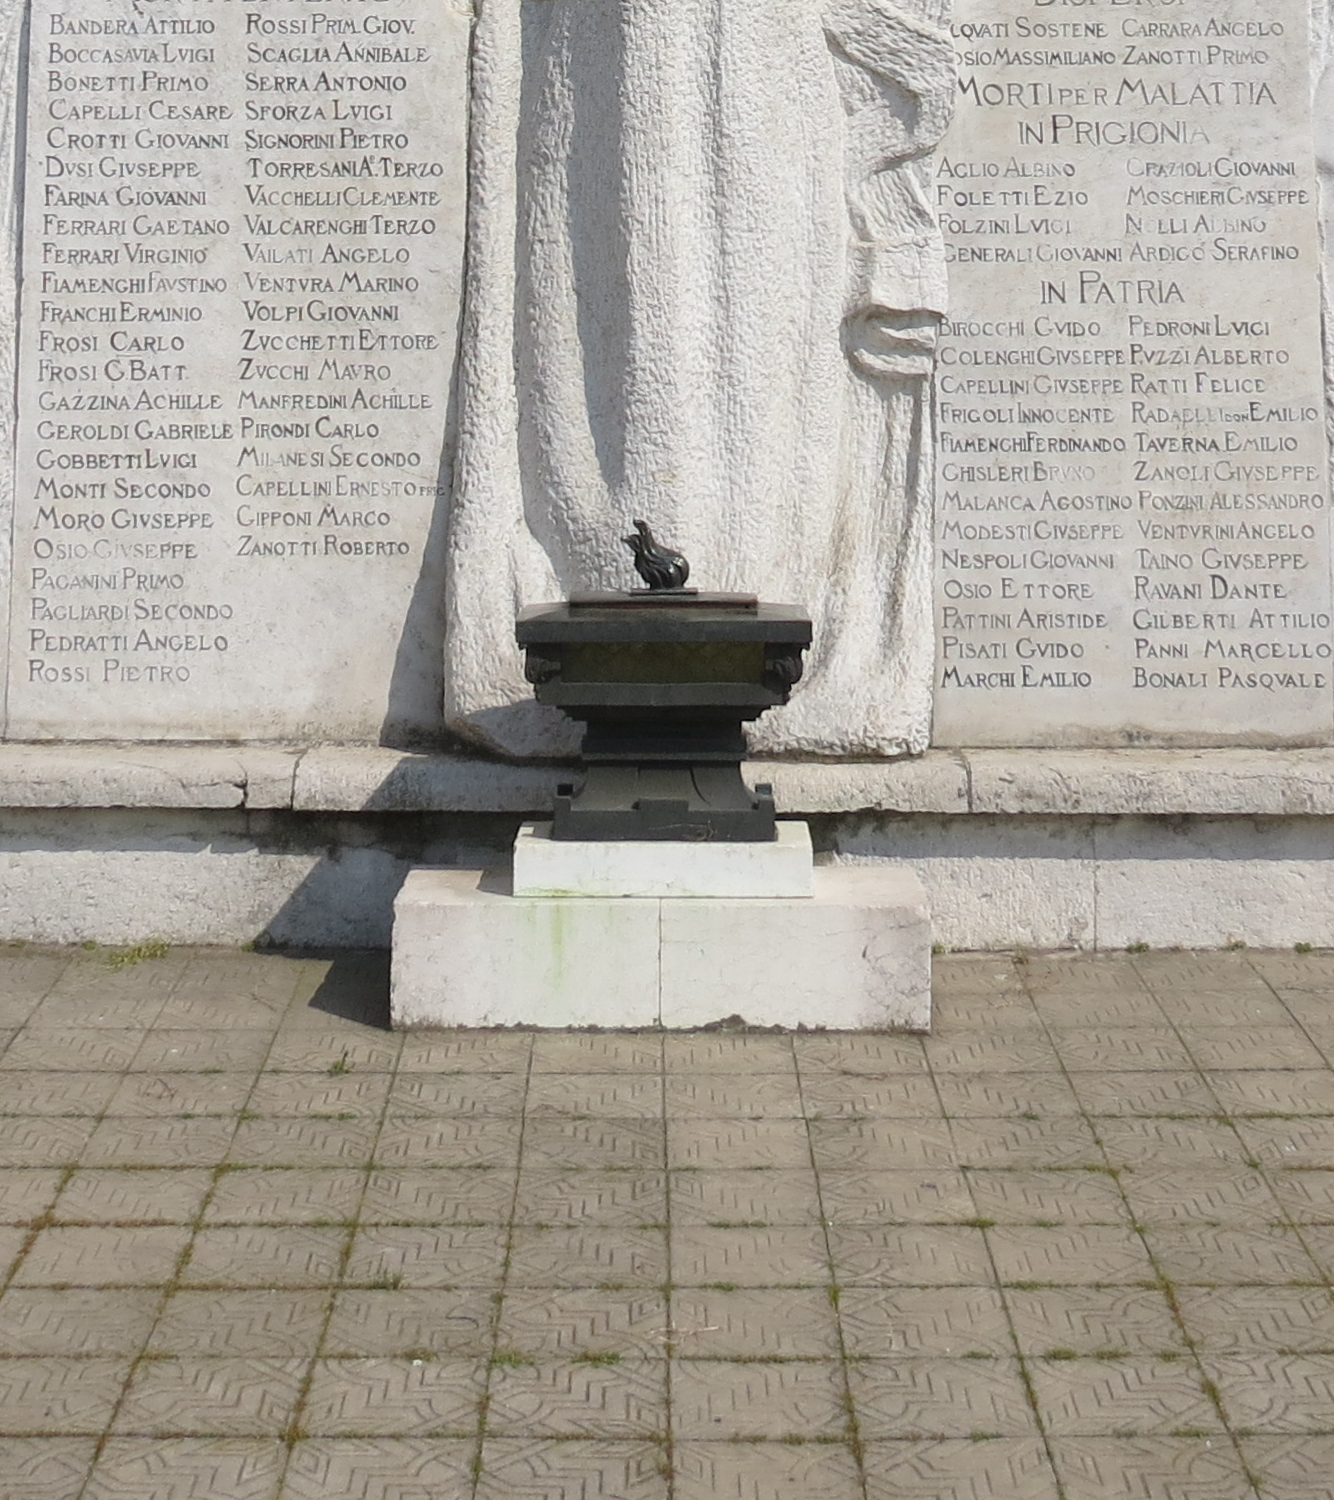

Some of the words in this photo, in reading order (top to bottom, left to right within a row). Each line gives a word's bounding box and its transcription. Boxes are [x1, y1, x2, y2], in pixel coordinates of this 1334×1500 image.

[50, 14, 138, 35] BANDERA
[145, 17, 215, 34] ATTILIO
[1016, 17, 1108, 38] SOSTENE
[1122, 19, 1200, 38] CARRARA
[1205, 18, 1283, 37] ANGELO
[247, 44, 331, 63] SCAGLIA
[335, 42, 431, 63] ANNIBALE
[1123, 47, 1201, 65] ZANOTTI
[1207, 47, 1268, 65] PRIMO
[49, 72, 135, 91] BONETTI
[141, 71, 208, 91] PRIMO
[246, 73, 308, 91] SERRA
[314, 72, 407, 91] ANTONIO
[958, 78, 1053, 108] MORTI
[1059, 87, 1107, 105] PER
[1115, 78, 1275, 107] MALATTIA
[49, 101, 141, 120] CAPELLI
[148, 101, 232, 120] CESARE
[246, 101, 325, 120] SFORZA
[47, 129, 126, 148] CROTTI
[135, 129, 228, 148] GIOVANNI
[245, 130, 334, 149] SIGNORINI
[339, 130, 408, 148] PIETRO
[1019, 123, 1043, 144] IN
[1052, 116, 1209, 146] PRIGIONIA
[45, 186, 107, 206] FARINA
[116, 186, 206, 206] GIOVANNI
[245, 186, 341, 206] VACCHELLI
[343, 186, 441, 206] CLEMENTE
[937, 187, 1029, 206] FOLETTI
[1035, 186, 1088, 206] EZIO
[44, 215, 125, 235] FERRARI
[133, 215, 230, 235] GAETANO
[244, 215, 367, 235] VALCARENGHI
[373, 215, 436, 235] TERZO
[43, 244, 119, 263] FERRARI
[123, 244, 206, 263] VIRGINIO
[1211, 238, 1298, 261] SERAFINO
[338, 272, 418, 291] MARINO
[1041, 281, 1065, 304] IN
[1079, 271, 1184, 305] PATRIA
[41, 302, 116, 322] FRANCHI
[121, 302, 202, 321] ERMINIO
[243, 301, 302, 321] VOLPI
[307, 301, 399, 321] GIOVANNI
[1129, 316, 1210, 337] PEDRONI
[39, 331, 97, 352] FROSI
[111, 331, 185, 351] CARLO
[358, 329, 438, 350] ETTORE
[940, 346, 1035, 366] COLENGHI
[1197, 345, 1289, 365] ALBERTO
[1131, 374, 1187, 397] RATTI
[1196, 372, 1265, 393] FELICE
[37, 421, 128, 441] GEROLDI
[135, 421, 233, 440] GABRIELE
[241, 418, 309, 438] PIRONDI
[315, 418, 379, 438] CARLO
[1135, 433, 1219, 453] TAVERNA
[1225, 430, 1298, 453] EMILIO
[36, 450, 142, 470] GOBBETTI
[34, 479, 105, 498] MONTI
[114, 479, 211, 498] SECONDO
[942, 491, 1034, 512] MALANCA
[1040, 491, 1132, 511] AGOSTINO
[33, 507, 104, 529] MORO
[237, 505, 311, 526] GIPPONI
[318, 504, 390, 527] MARCO
[942, 520, 1031, 541] MODESTI
[1239, 518, 1314, 539] ANGELO
[236, 535, 316, 556] ZANOTTI
[323, 534, 410, 555] ROBERTO
[942, 549, 1027, 569] NESPOLI
[1031, 549, 1113, 569] GIOVANNI
[1136, 549, 1192, 569] TAINO
[944, 579, 992, 599] OSIO
[1002, 578, 1094, 599] ETTORE
[1134, 576, 1202, 600] RAVANI
[1211, 575, 1286, 599] DANTE
[942, 607, 1011, 629] PATTINI
[1019, 607, 1108, 628] ARISTIDE
[1133, 608, 1234, 629] GILBERTI
[1250, 607, 1330, 629] ATTILIO
[29, 630, 127, 651] PEDRATTI
[134, 630, 227, 651] ANGELO
[942, 637, 1006, 658] PISATI
[1135, 638, 1188, 658] PANNI
[1204, 639, 1332, 658] MARCELLO
[29, 661, 90, 682] ROSSI
[103, 660, 190, 682] PIETRO
[941, 666, 1014, 689] MARCHI
[1021, 666, 1091, 687] EMILIO
[1133, 667, 1207, 688] BONALI
